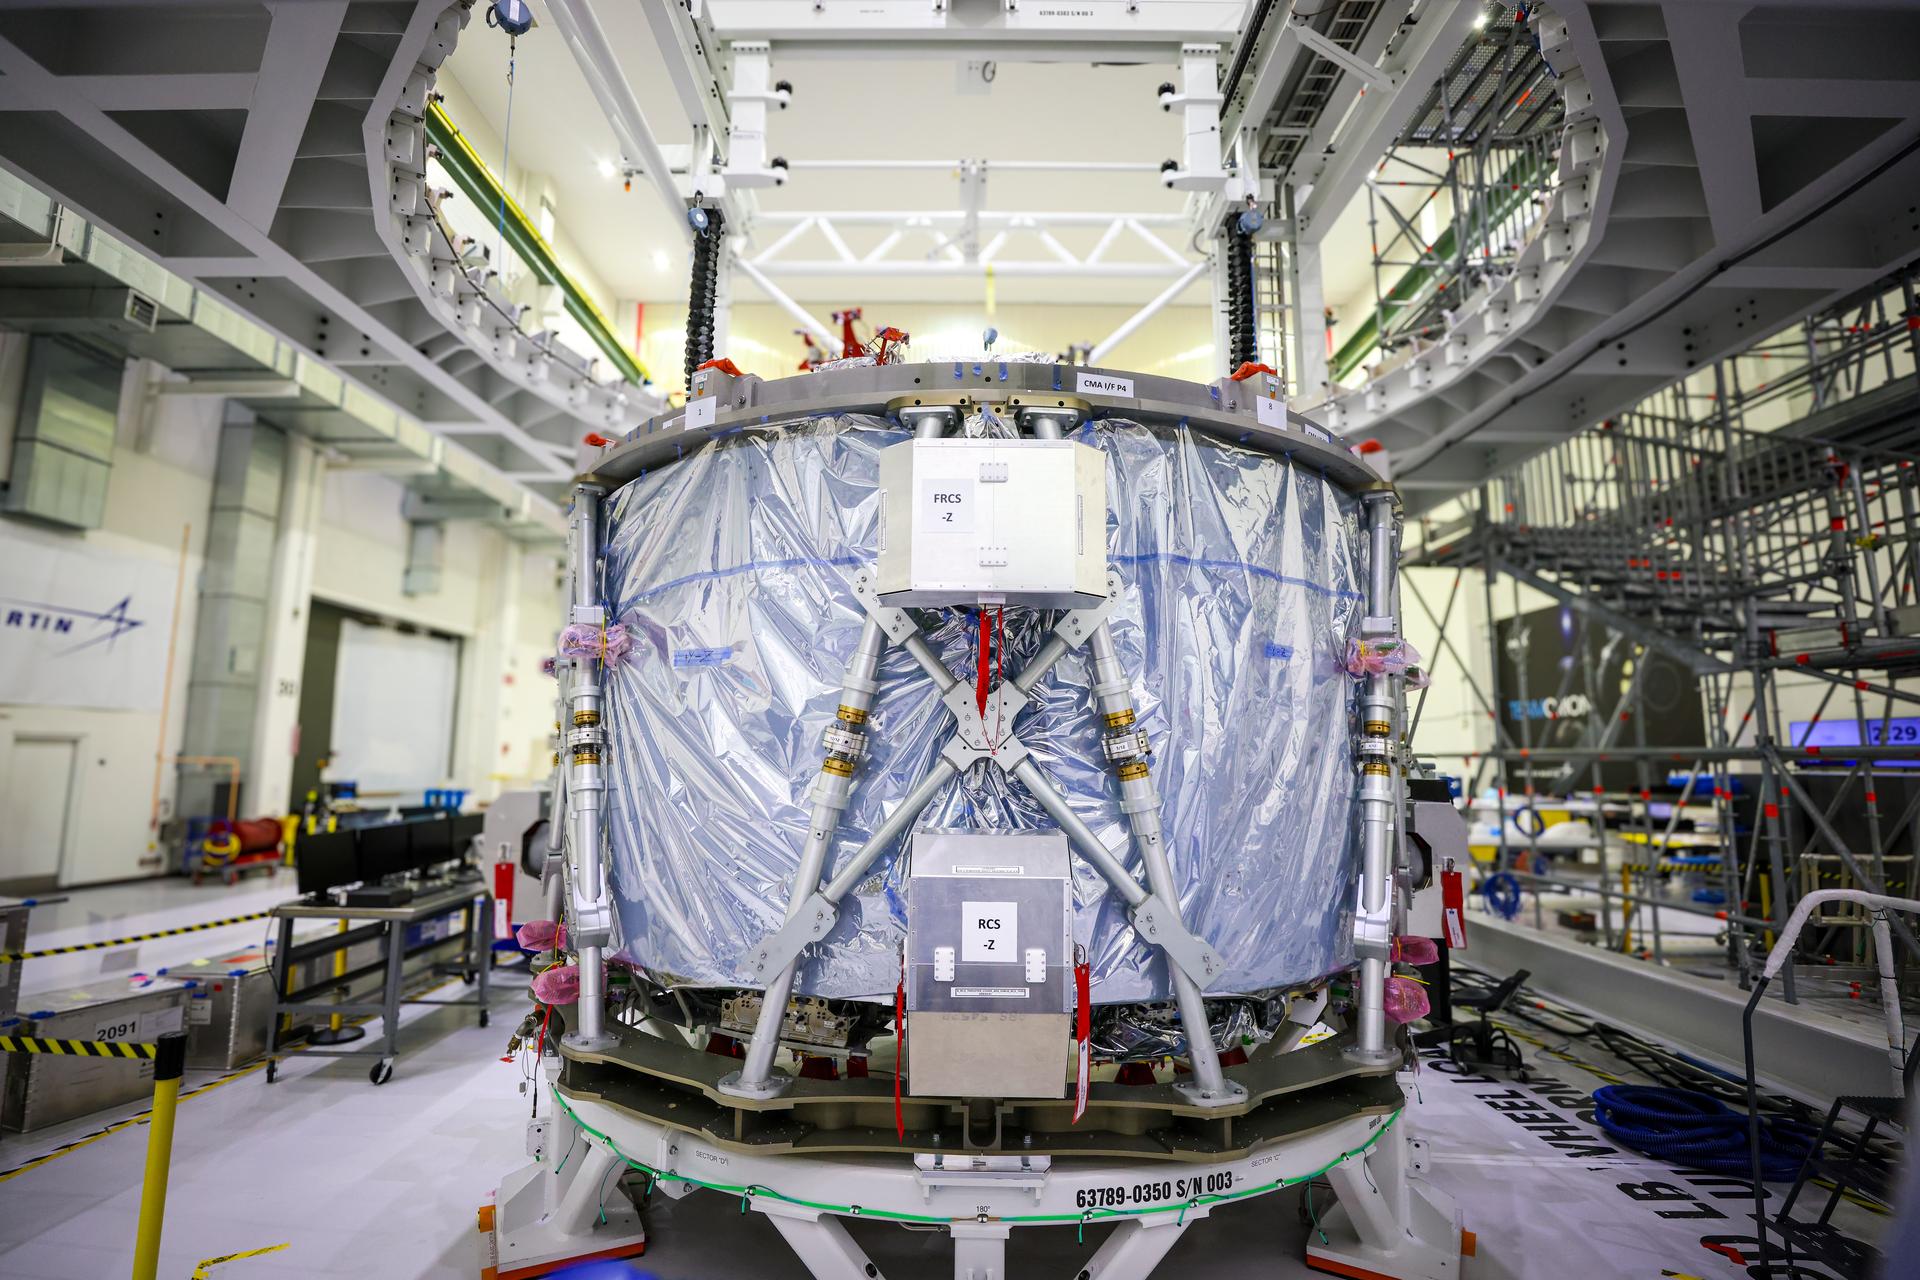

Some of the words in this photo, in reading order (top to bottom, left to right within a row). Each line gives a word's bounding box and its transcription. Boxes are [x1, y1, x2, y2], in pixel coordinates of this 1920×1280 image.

[1084, 380, 1103, 389] CMA
[1117, 384, 1127, 392] P4
[1268, 402, 1273, 411] 8
[934, 494, 962, 503] FRCS
[942, 512, 953, 522] -Z
[0, 609, 74, 633] RTIN
[978, 919, 1001, 930] RCS
[983, 940, 995, 950] -Z
[97, 1020, 136, 1041] 2091
[695, 1150, 717, 1162] SECTOR
[1251, 1156, 1273, 1168] SECTOR
[1076, 1181, 1171, 1208] 63789-0350
[1176, 1176, 1202, 1199] S/N
[1207, 1171, 1232, 1193] 003
